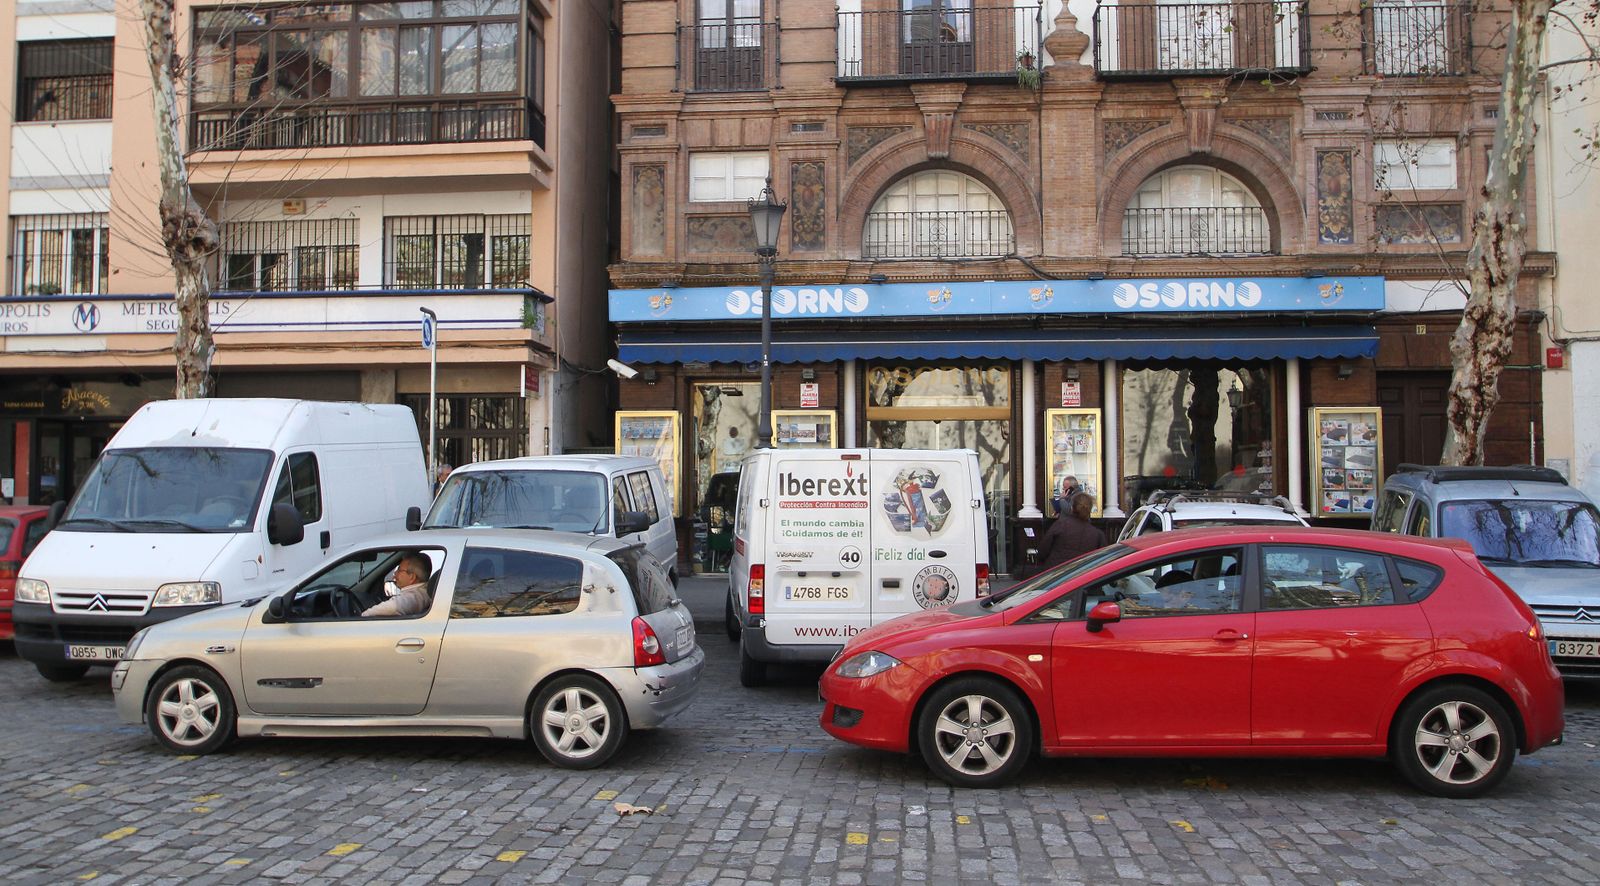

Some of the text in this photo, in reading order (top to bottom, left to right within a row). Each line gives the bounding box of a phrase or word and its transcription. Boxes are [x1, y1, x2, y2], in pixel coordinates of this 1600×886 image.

[726, 287, 869, 315] OSORNO
[1112, 281, 1262, 308] OSORNO
[779, 472, 868, 496] Iberext
[780, 501, 867, 509] Protección Contra Incendios
[793, 519, 826, 527] mundo
[828, 519, 865, 527] cambia
[782, 530, 834, 538] ¡Cuidamos
[836, 530, 849, 538] de
[841, 551, 860, 563] 40
[874, 547, 926, 561] ¡Feliz día!
[793, 587, 848, 598] 4768 FGS
[71, 646, 124, 659] 0855 DWG
[1558, 643, 1594, 656] 8372
